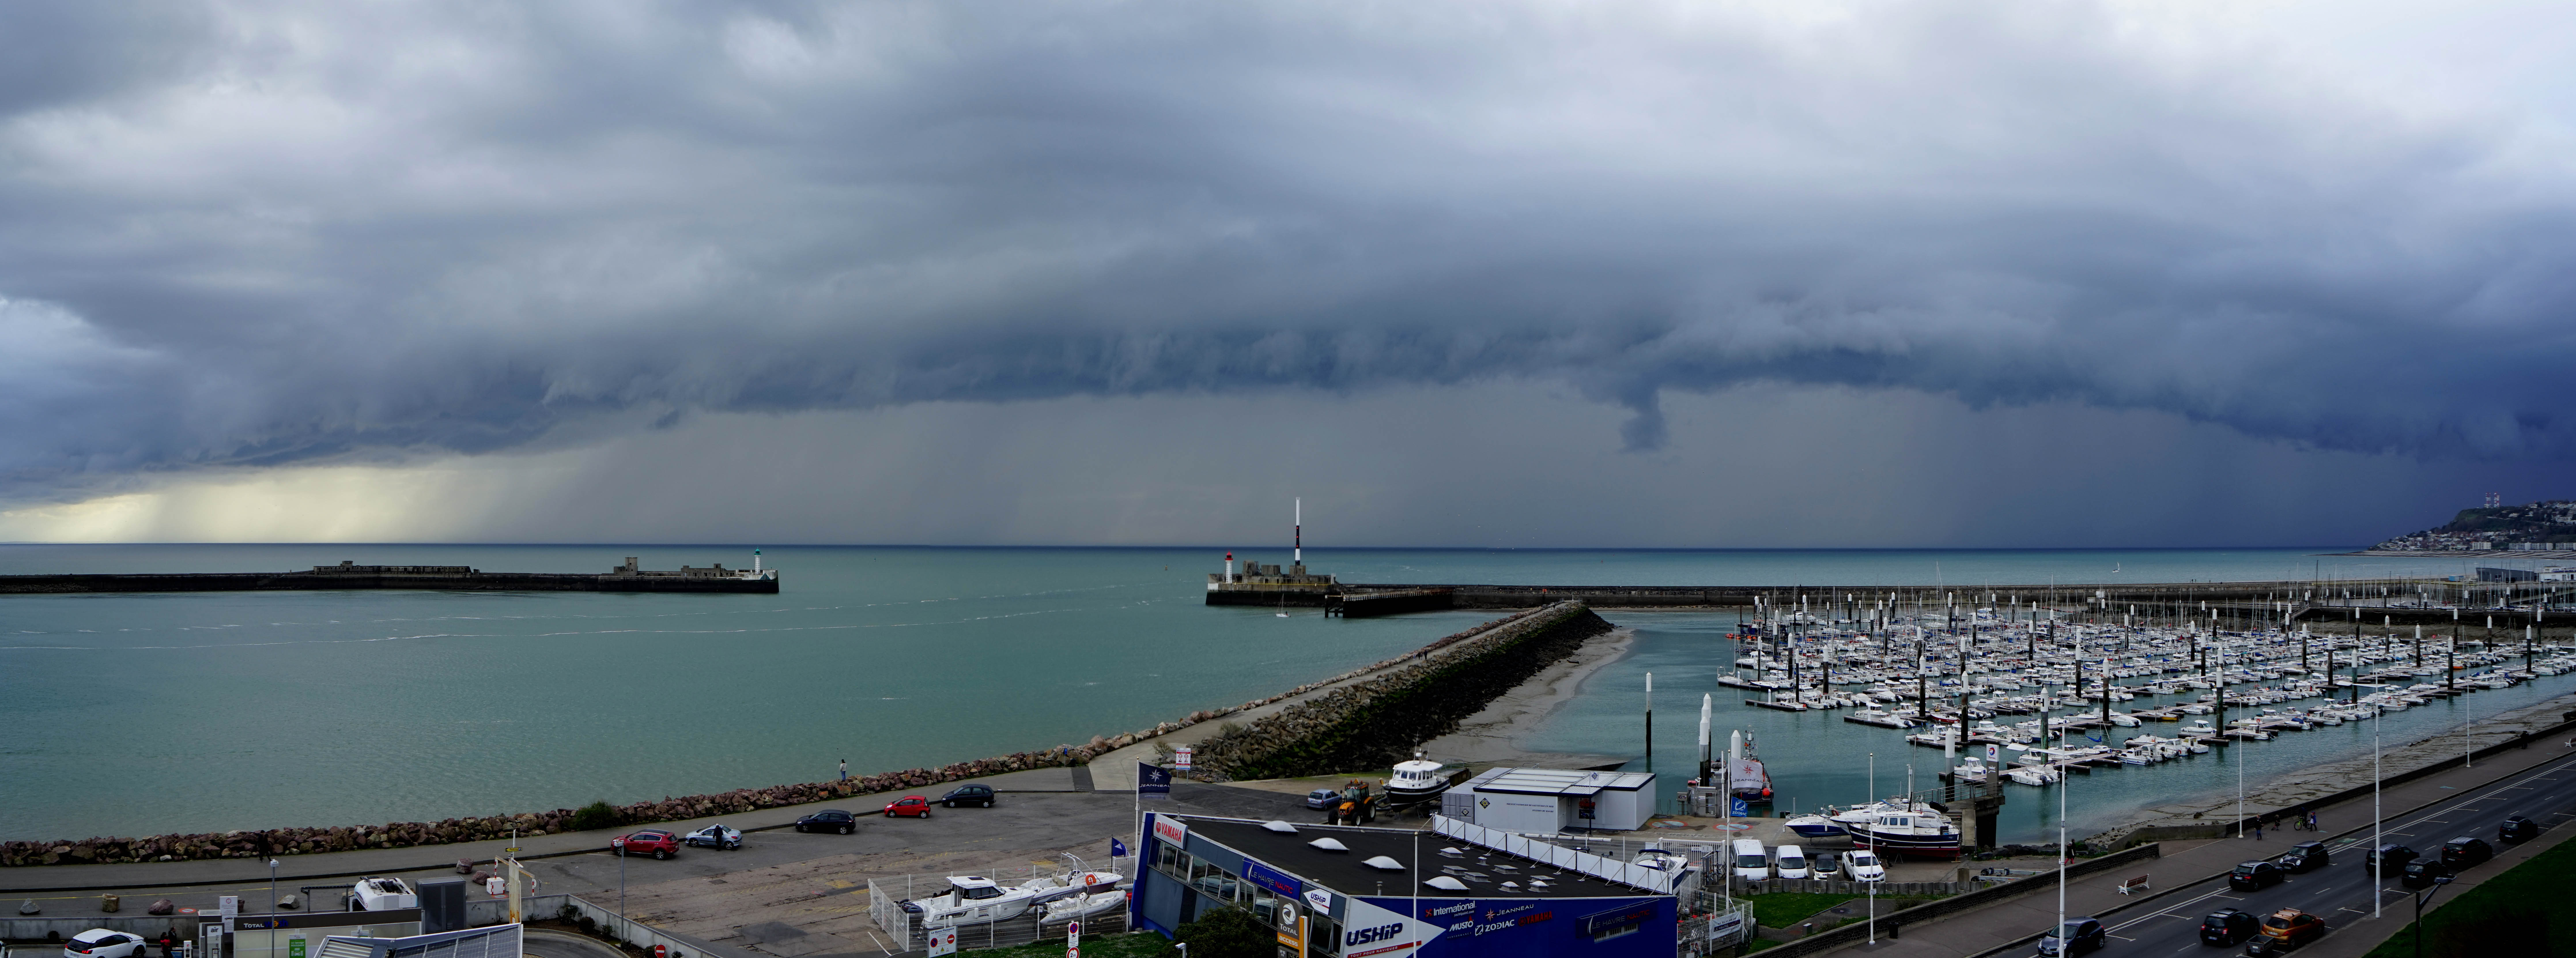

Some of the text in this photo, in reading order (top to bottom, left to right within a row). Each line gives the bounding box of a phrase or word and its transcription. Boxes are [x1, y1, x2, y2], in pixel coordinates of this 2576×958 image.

[1162, 823, 1182, 842] YAMAHA
[1258, 874, 1274, 886] HAVRE
[1275, 881, 1293, 894] NAUTIC
[1434, 901, 1475, 916] International
[1497, 904, 1534, 916] JEANNEAU
[264, 918, 288, 928] wash
[1526, 911, 1553, 924] YAMAHA
[1603, 916, 1625, 926] HAVRE
[1627, 910, 1650, 920] NAUTIC
[1279, 923, 1298, 936] TOTAL
[1449, 921, 1474, 932] MUSTO
[1485, 919, 1514, 932] ZODIAC
[1279, 936, 1298, 946] access
